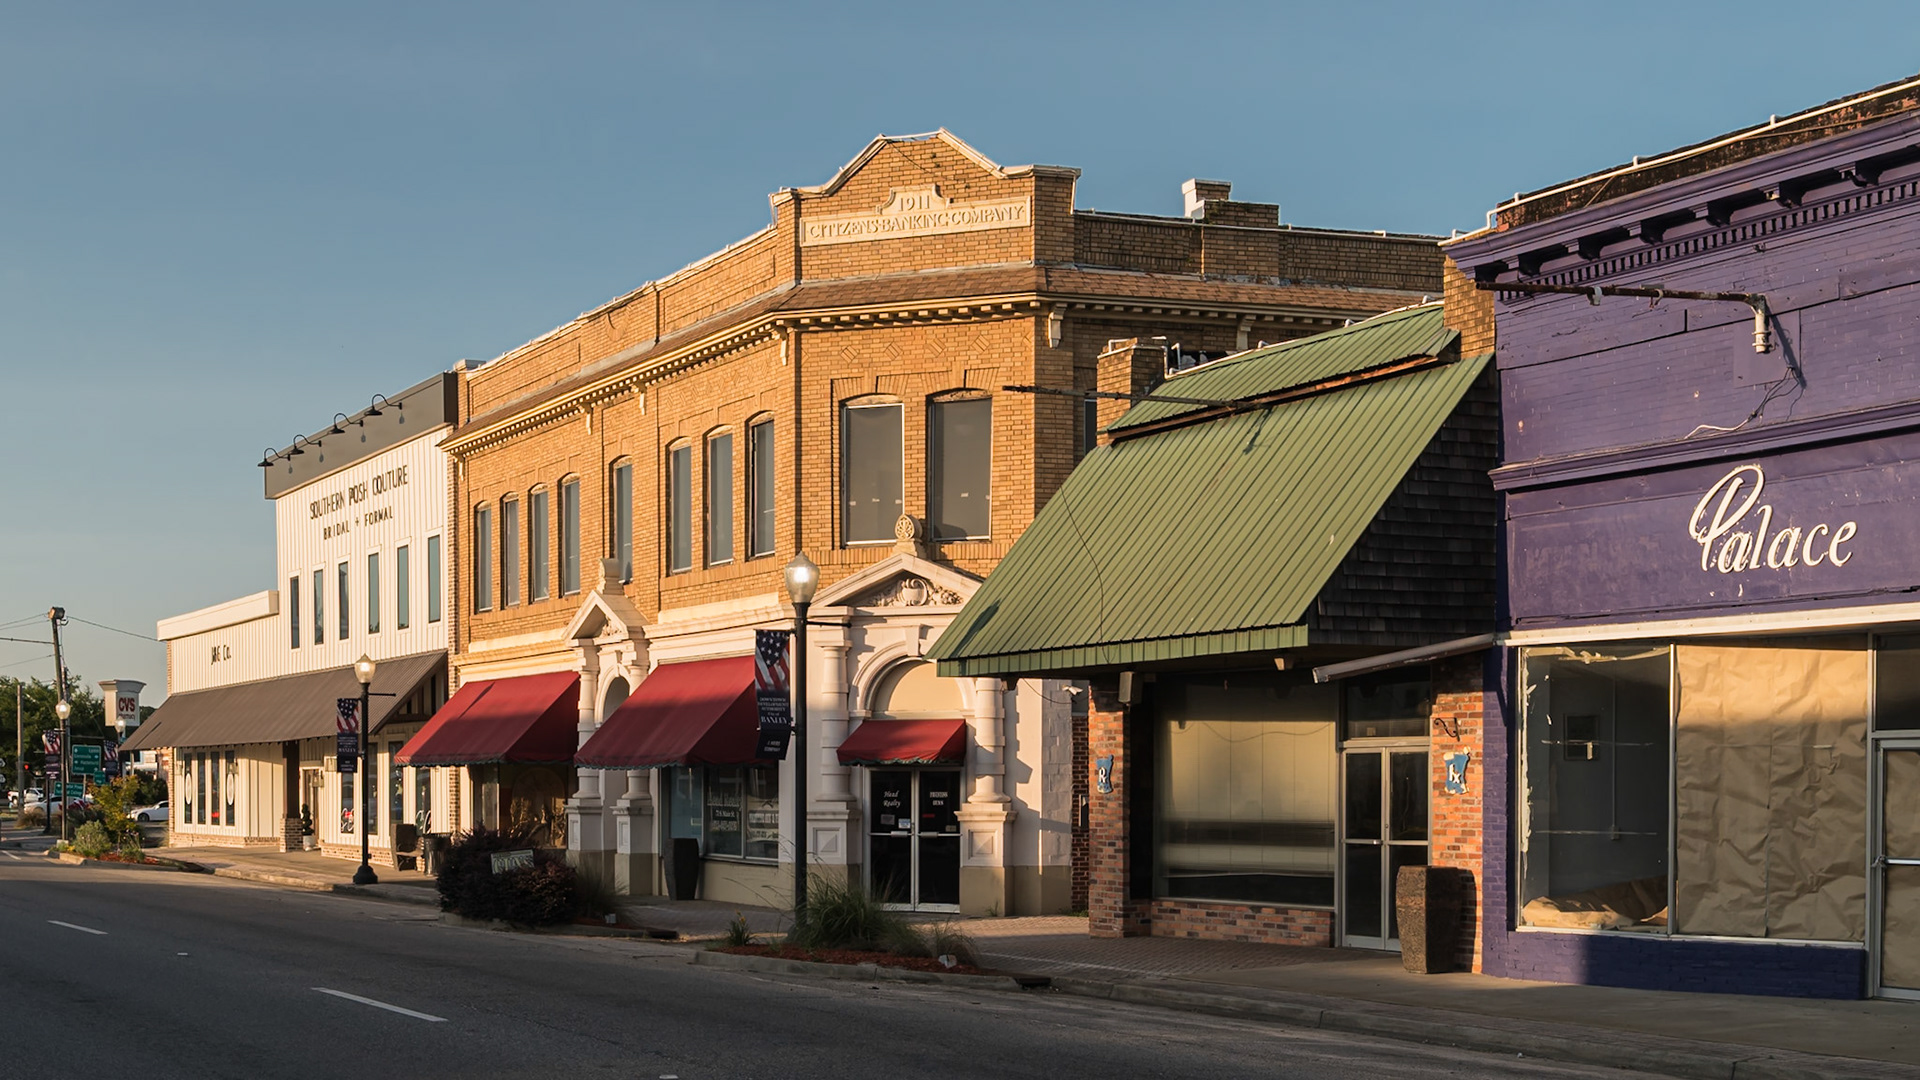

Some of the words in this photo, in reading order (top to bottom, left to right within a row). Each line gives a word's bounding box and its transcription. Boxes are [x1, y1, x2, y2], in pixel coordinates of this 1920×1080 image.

[900, 194, 930, 211] 1911
[882, 211, 948, 233] BANKING
[310, 490, 345, 520] SOUTHERN
[348, 480, 369, 506] POSH
[372, 465, 408, 496] COUTURE
[323, 520, 350, 540] BRIDAL
[364, 506, 393, 527] FORMAL
[1688, 464, 1857, 574] Palace
[118, 697, 135, 712] CVS
[883, 799, 901, 808] Realty
